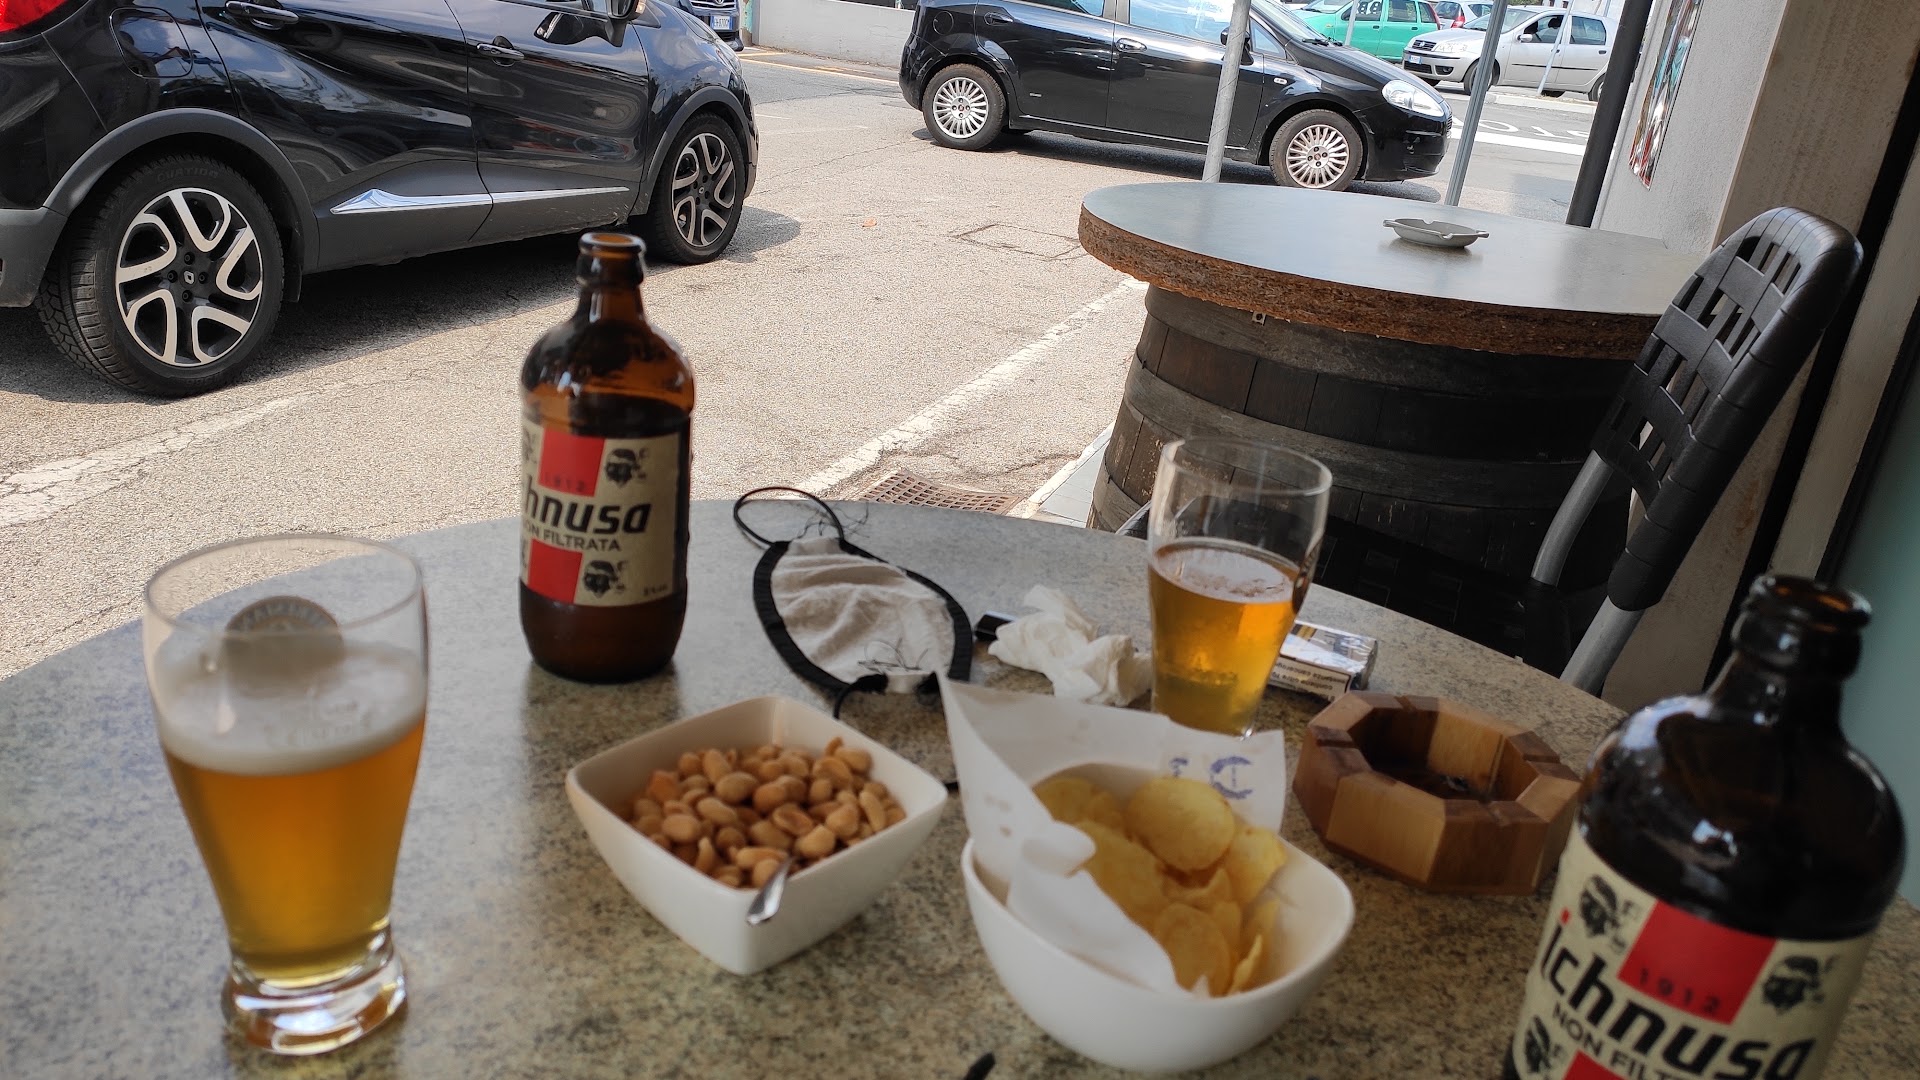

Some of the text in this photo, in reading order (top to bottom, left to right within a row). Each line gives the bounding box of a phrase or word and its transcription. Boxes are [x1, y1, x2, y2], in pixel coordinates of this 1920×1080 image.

[525, 474, 652, 534] hnusa
[544, 471, 586, 493] 1912
[543, 529, 621, 552] FILTRATA
[1540, 908, 1817, 1080] ichnusa
[1638, 967, 1721, 1016] 1912
[1552, 1000, 1605, 1057] NON
